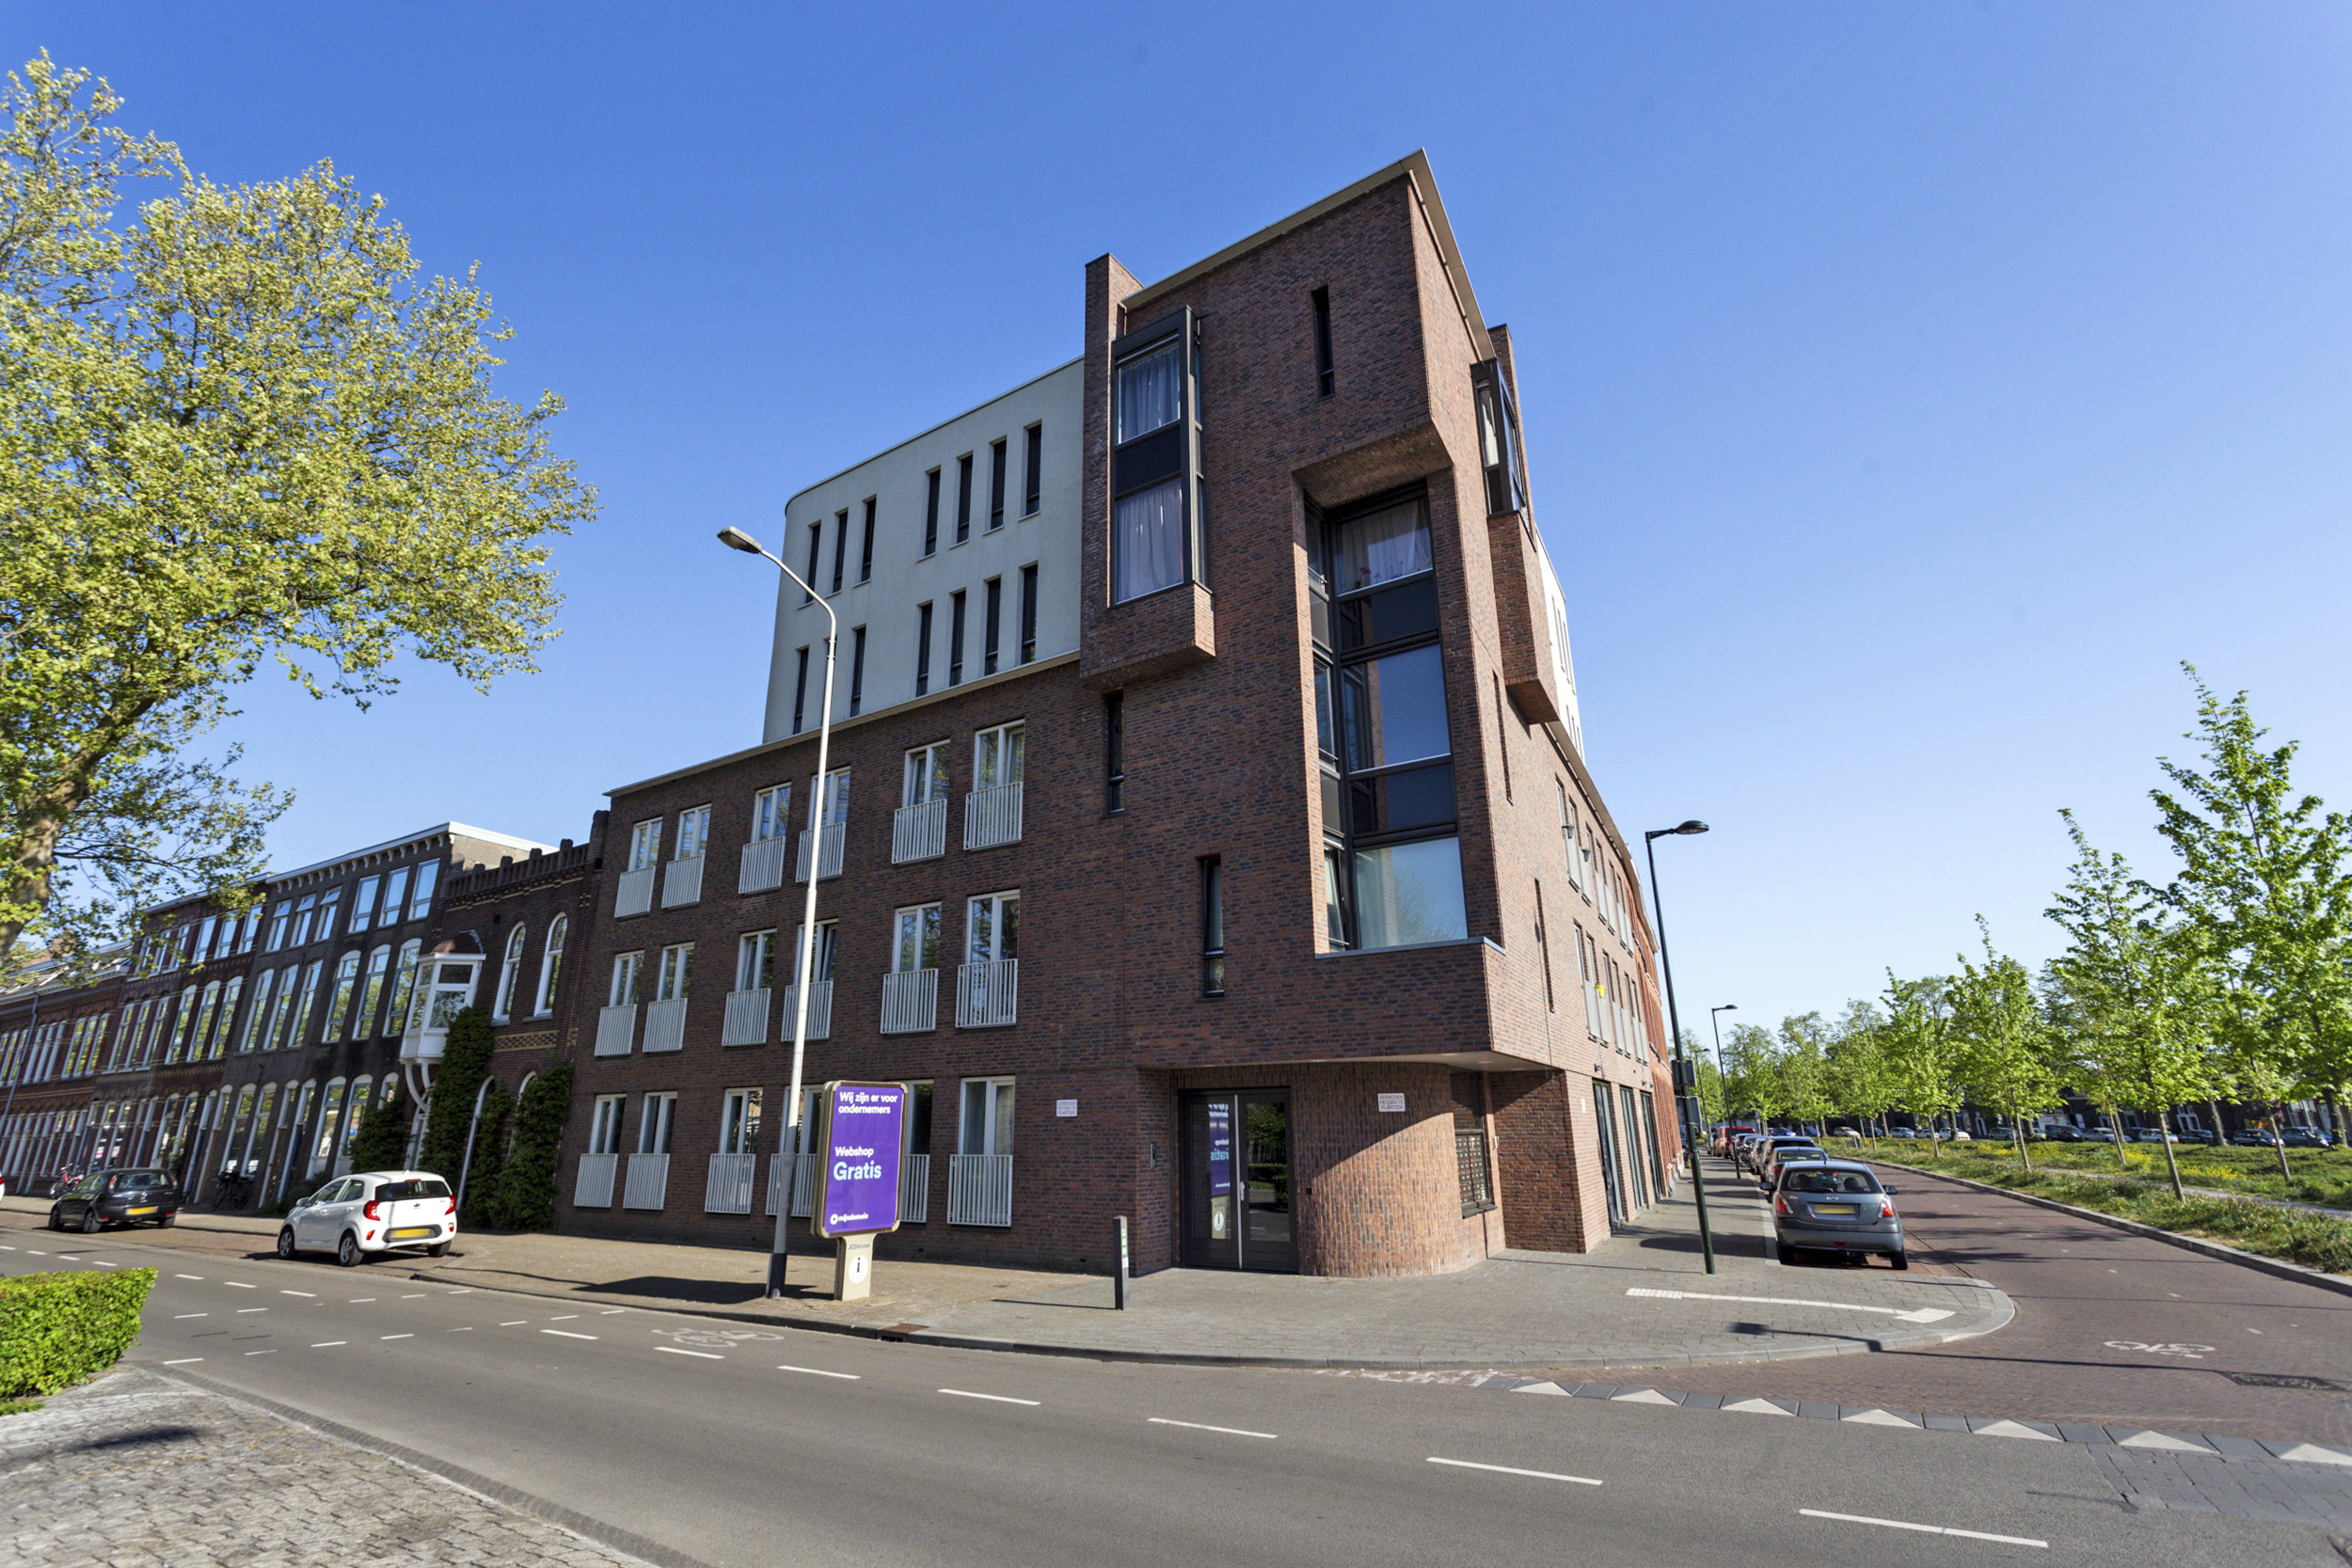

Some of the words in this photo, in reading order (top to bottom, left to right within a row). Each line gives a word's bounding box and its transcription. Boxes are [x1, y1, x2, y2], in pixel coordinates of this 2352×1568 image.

[839, 1091, 853, 1104] Wij
[855, 1091, 869, 1104] zijn
[838, 1103, 891, 1114] ondernemers
[835, 1146, 874, 1158] Webshop
[834, 1160, 882, 1180] Gratis
